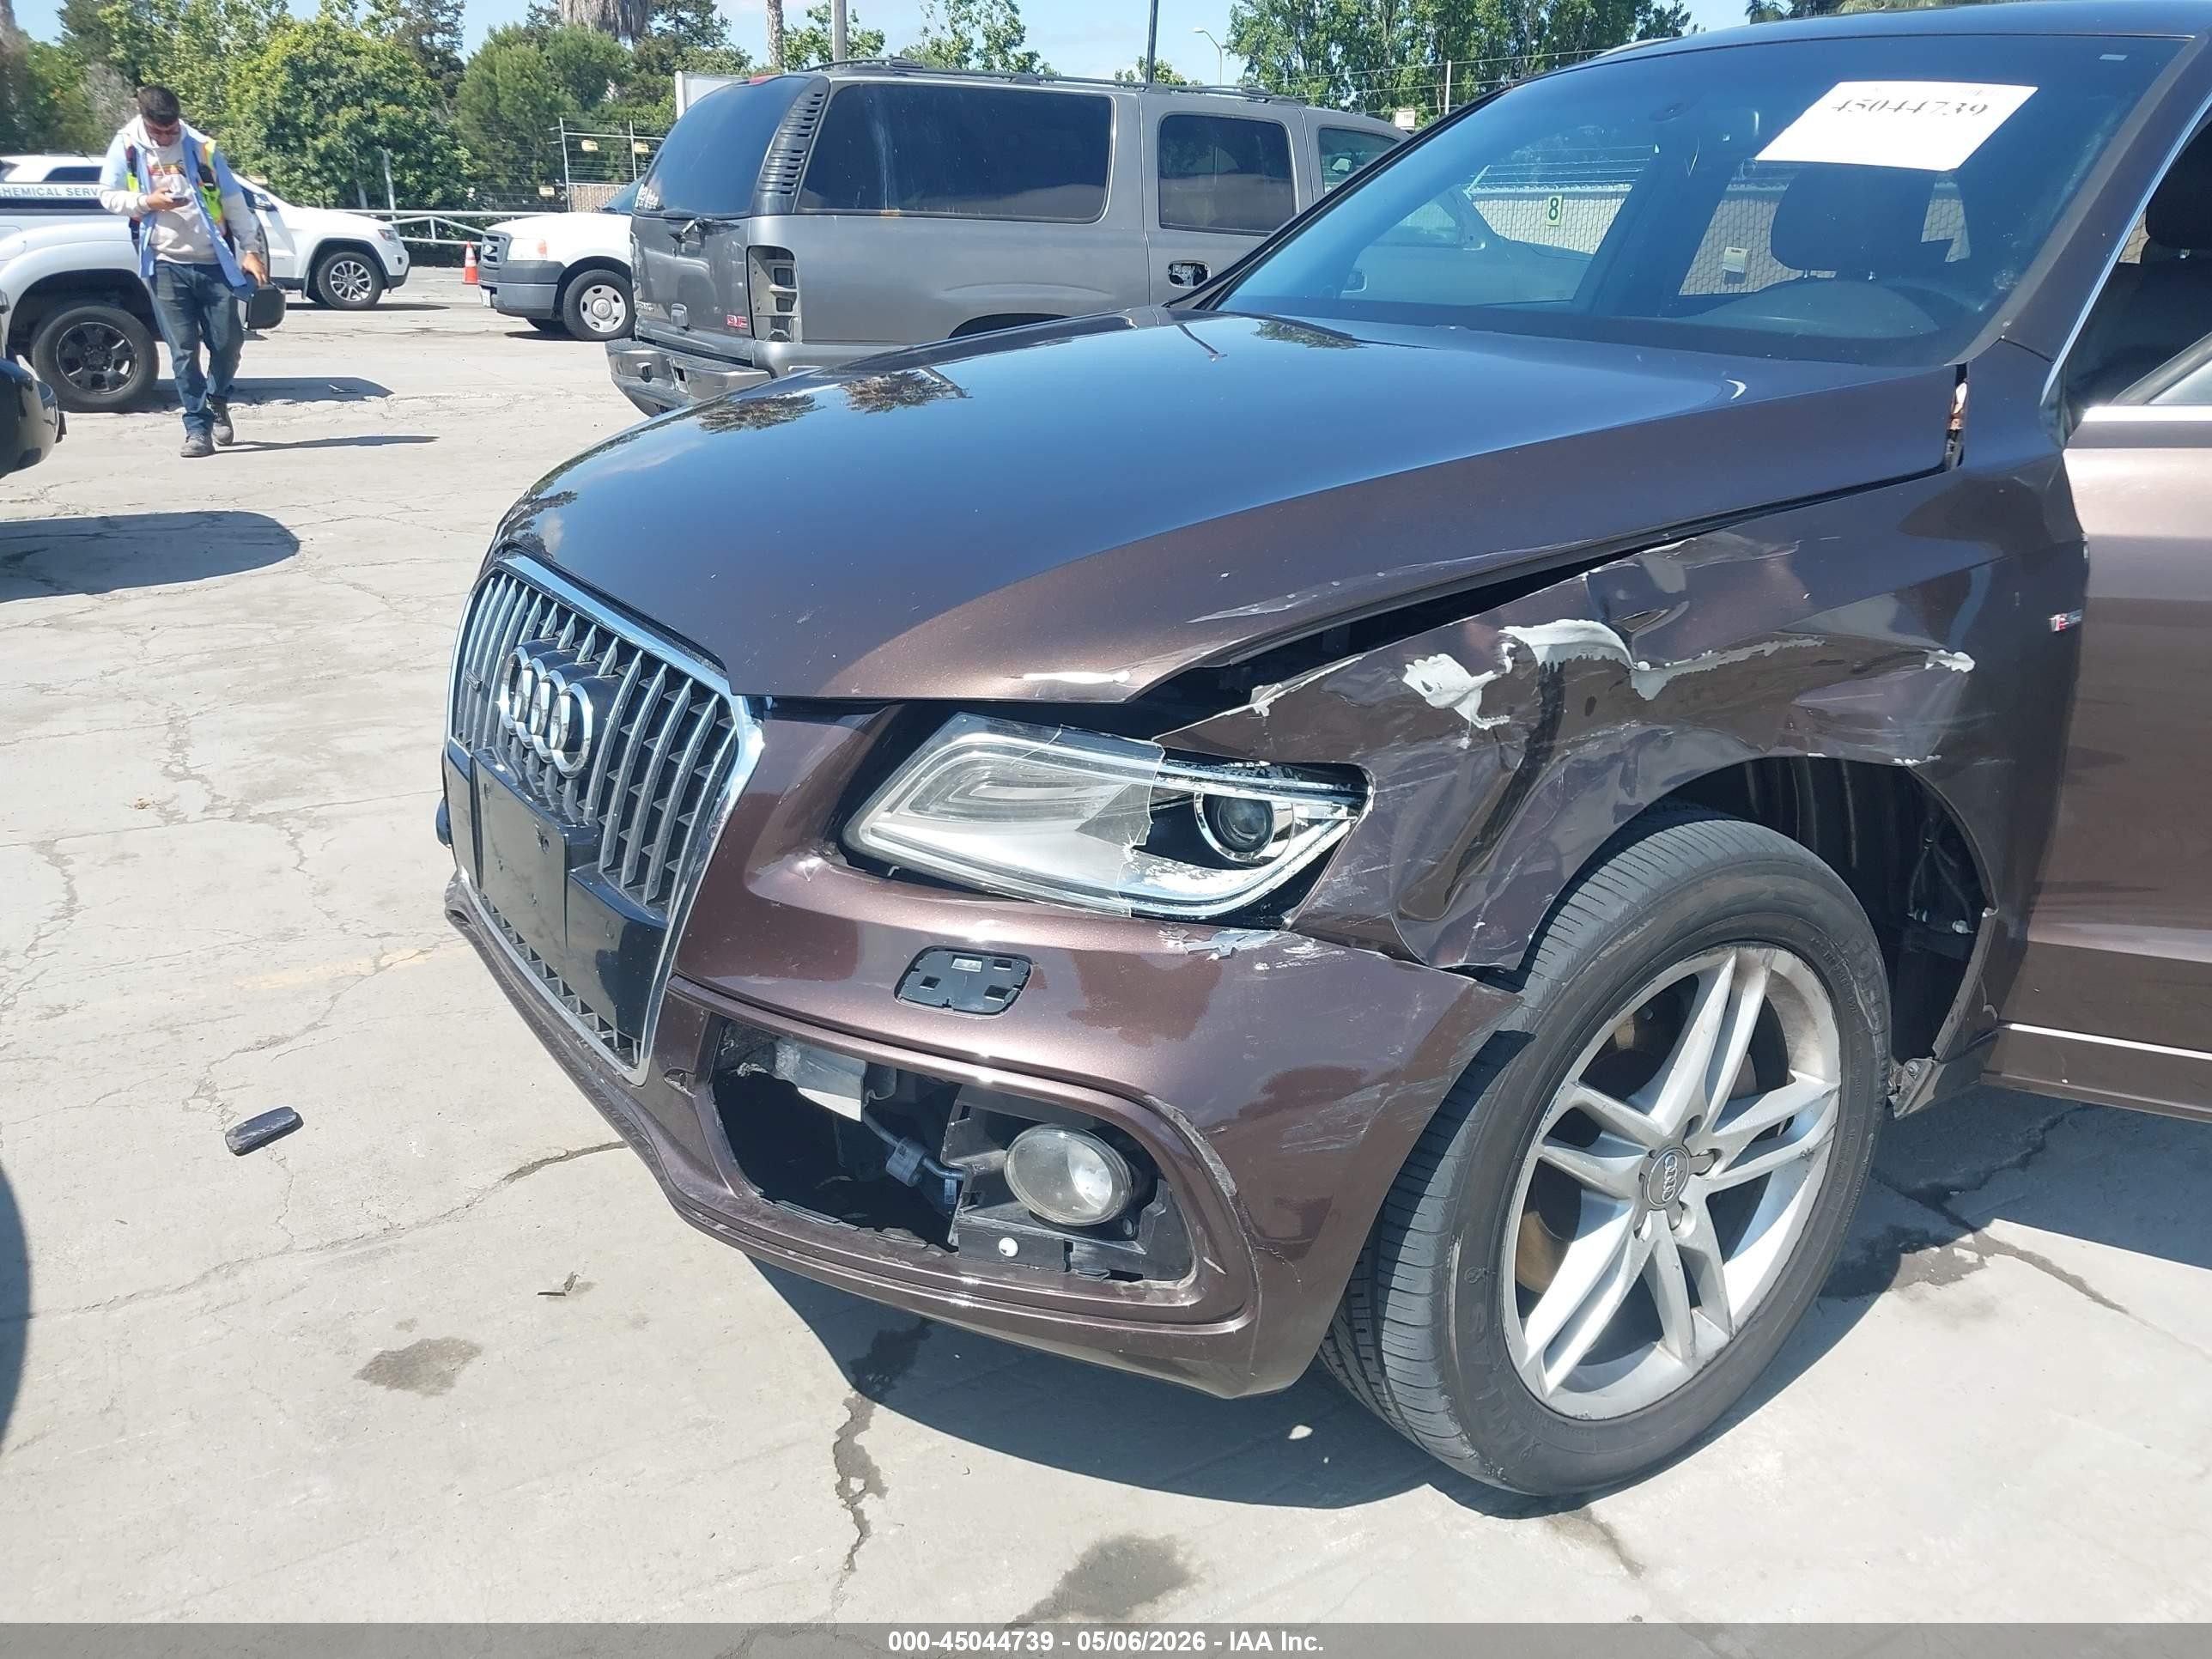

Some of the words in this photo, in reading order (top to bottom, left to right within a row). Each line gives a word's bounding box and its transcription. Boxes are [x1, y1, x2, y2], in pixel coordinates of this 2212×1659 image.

[1832, 99, 1989, 116] 45044739
[0, 187, 62, 197] HEMICAL
[1548, 197, 1559, 221] 8
